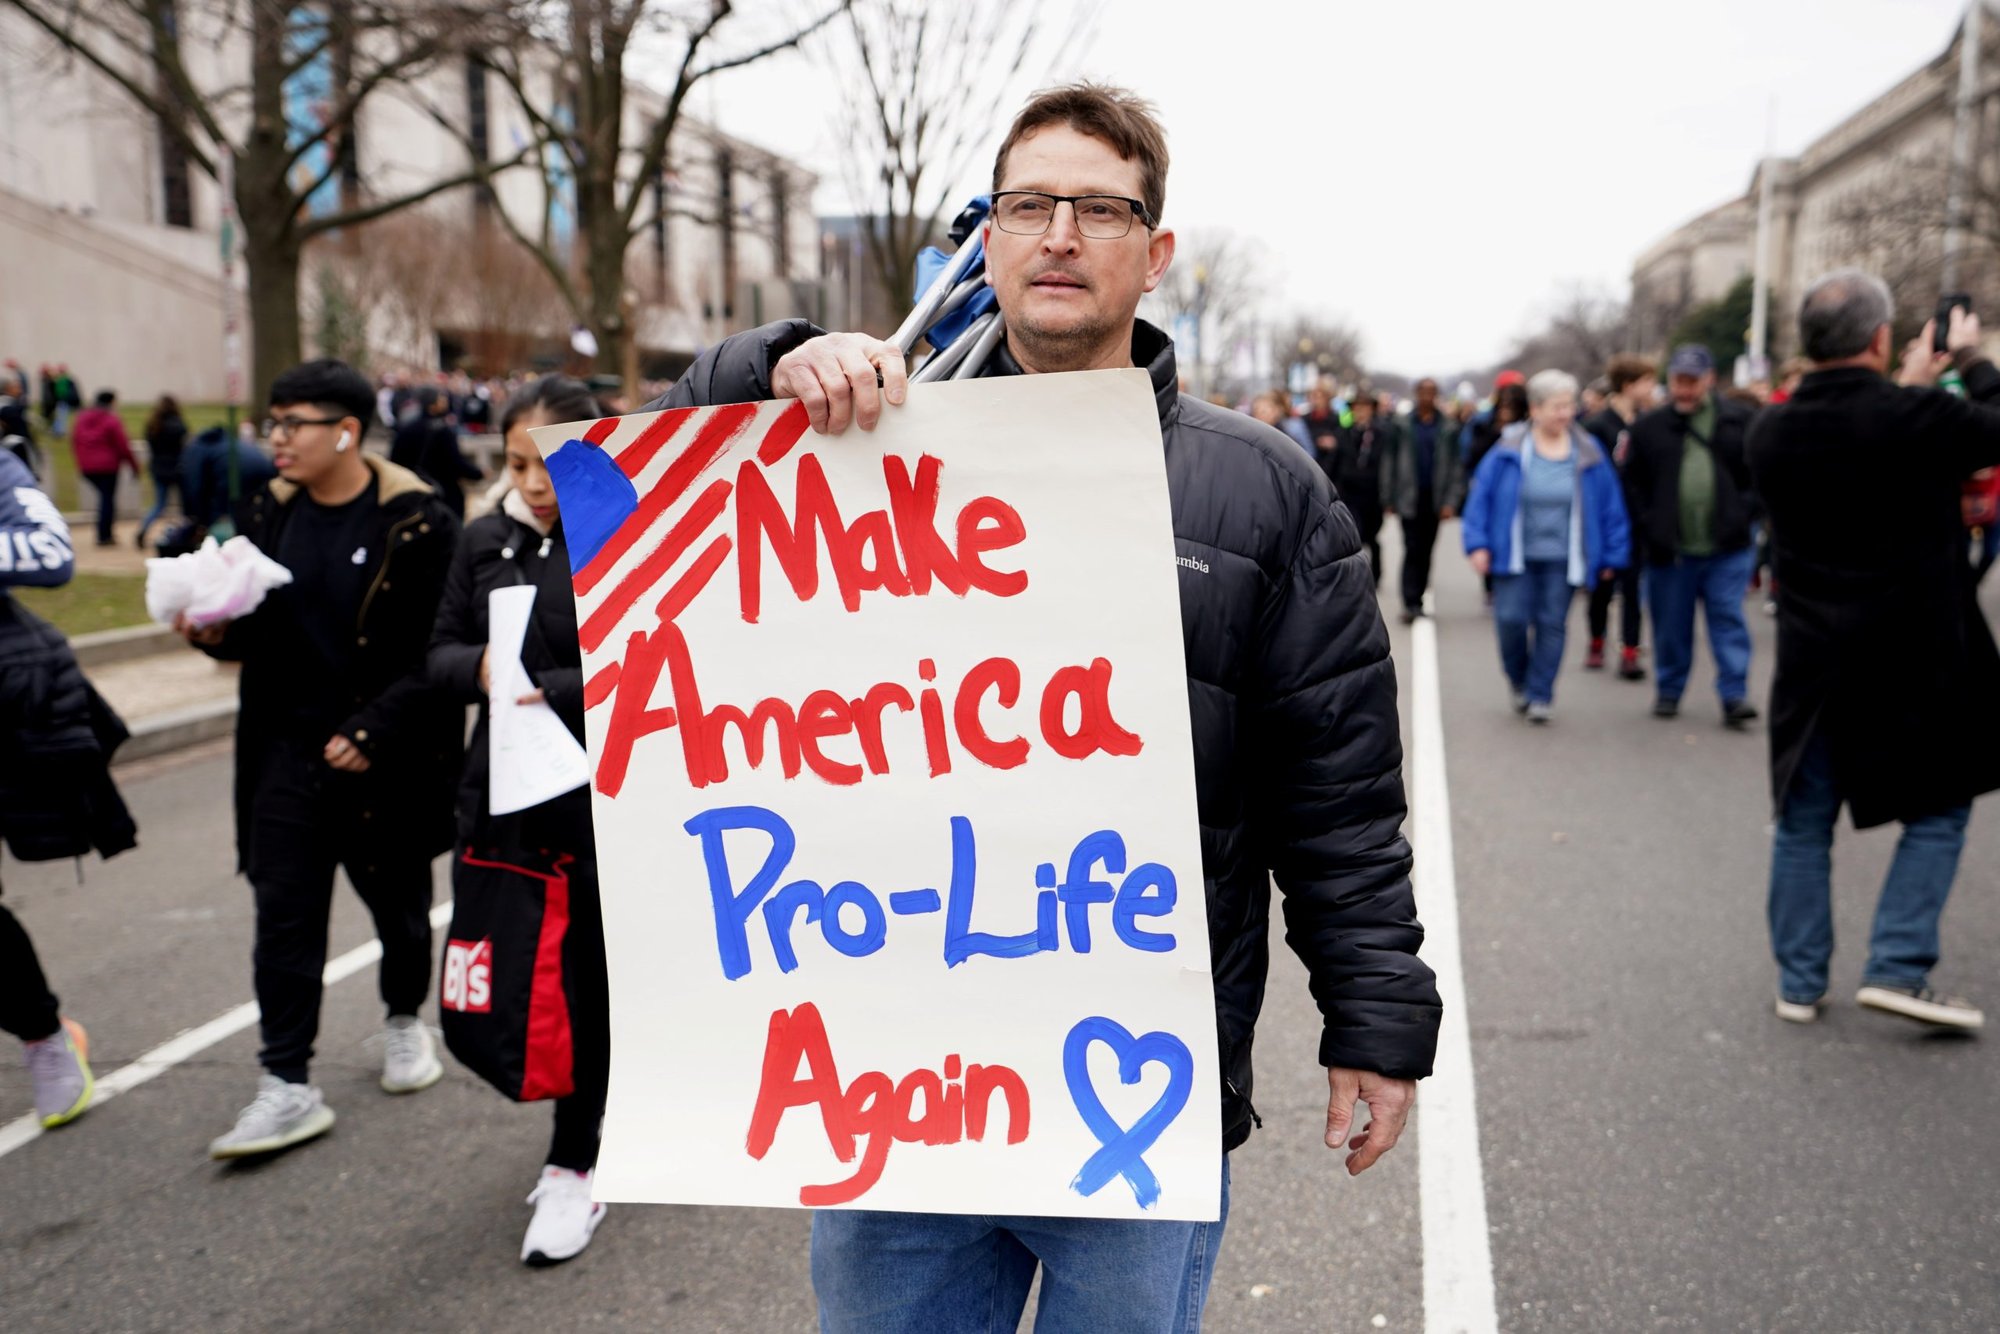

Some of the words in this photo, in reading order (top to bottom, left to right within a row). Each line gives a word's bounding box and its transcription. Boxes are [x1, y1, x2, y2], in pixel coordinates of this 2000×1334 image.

[735, 452, 1029, 624] Make
[595, 621, 1144, 799] America
[683, 805, 1178, 982] Pro-Life
[746, 1001, 1031, 1206] Again
